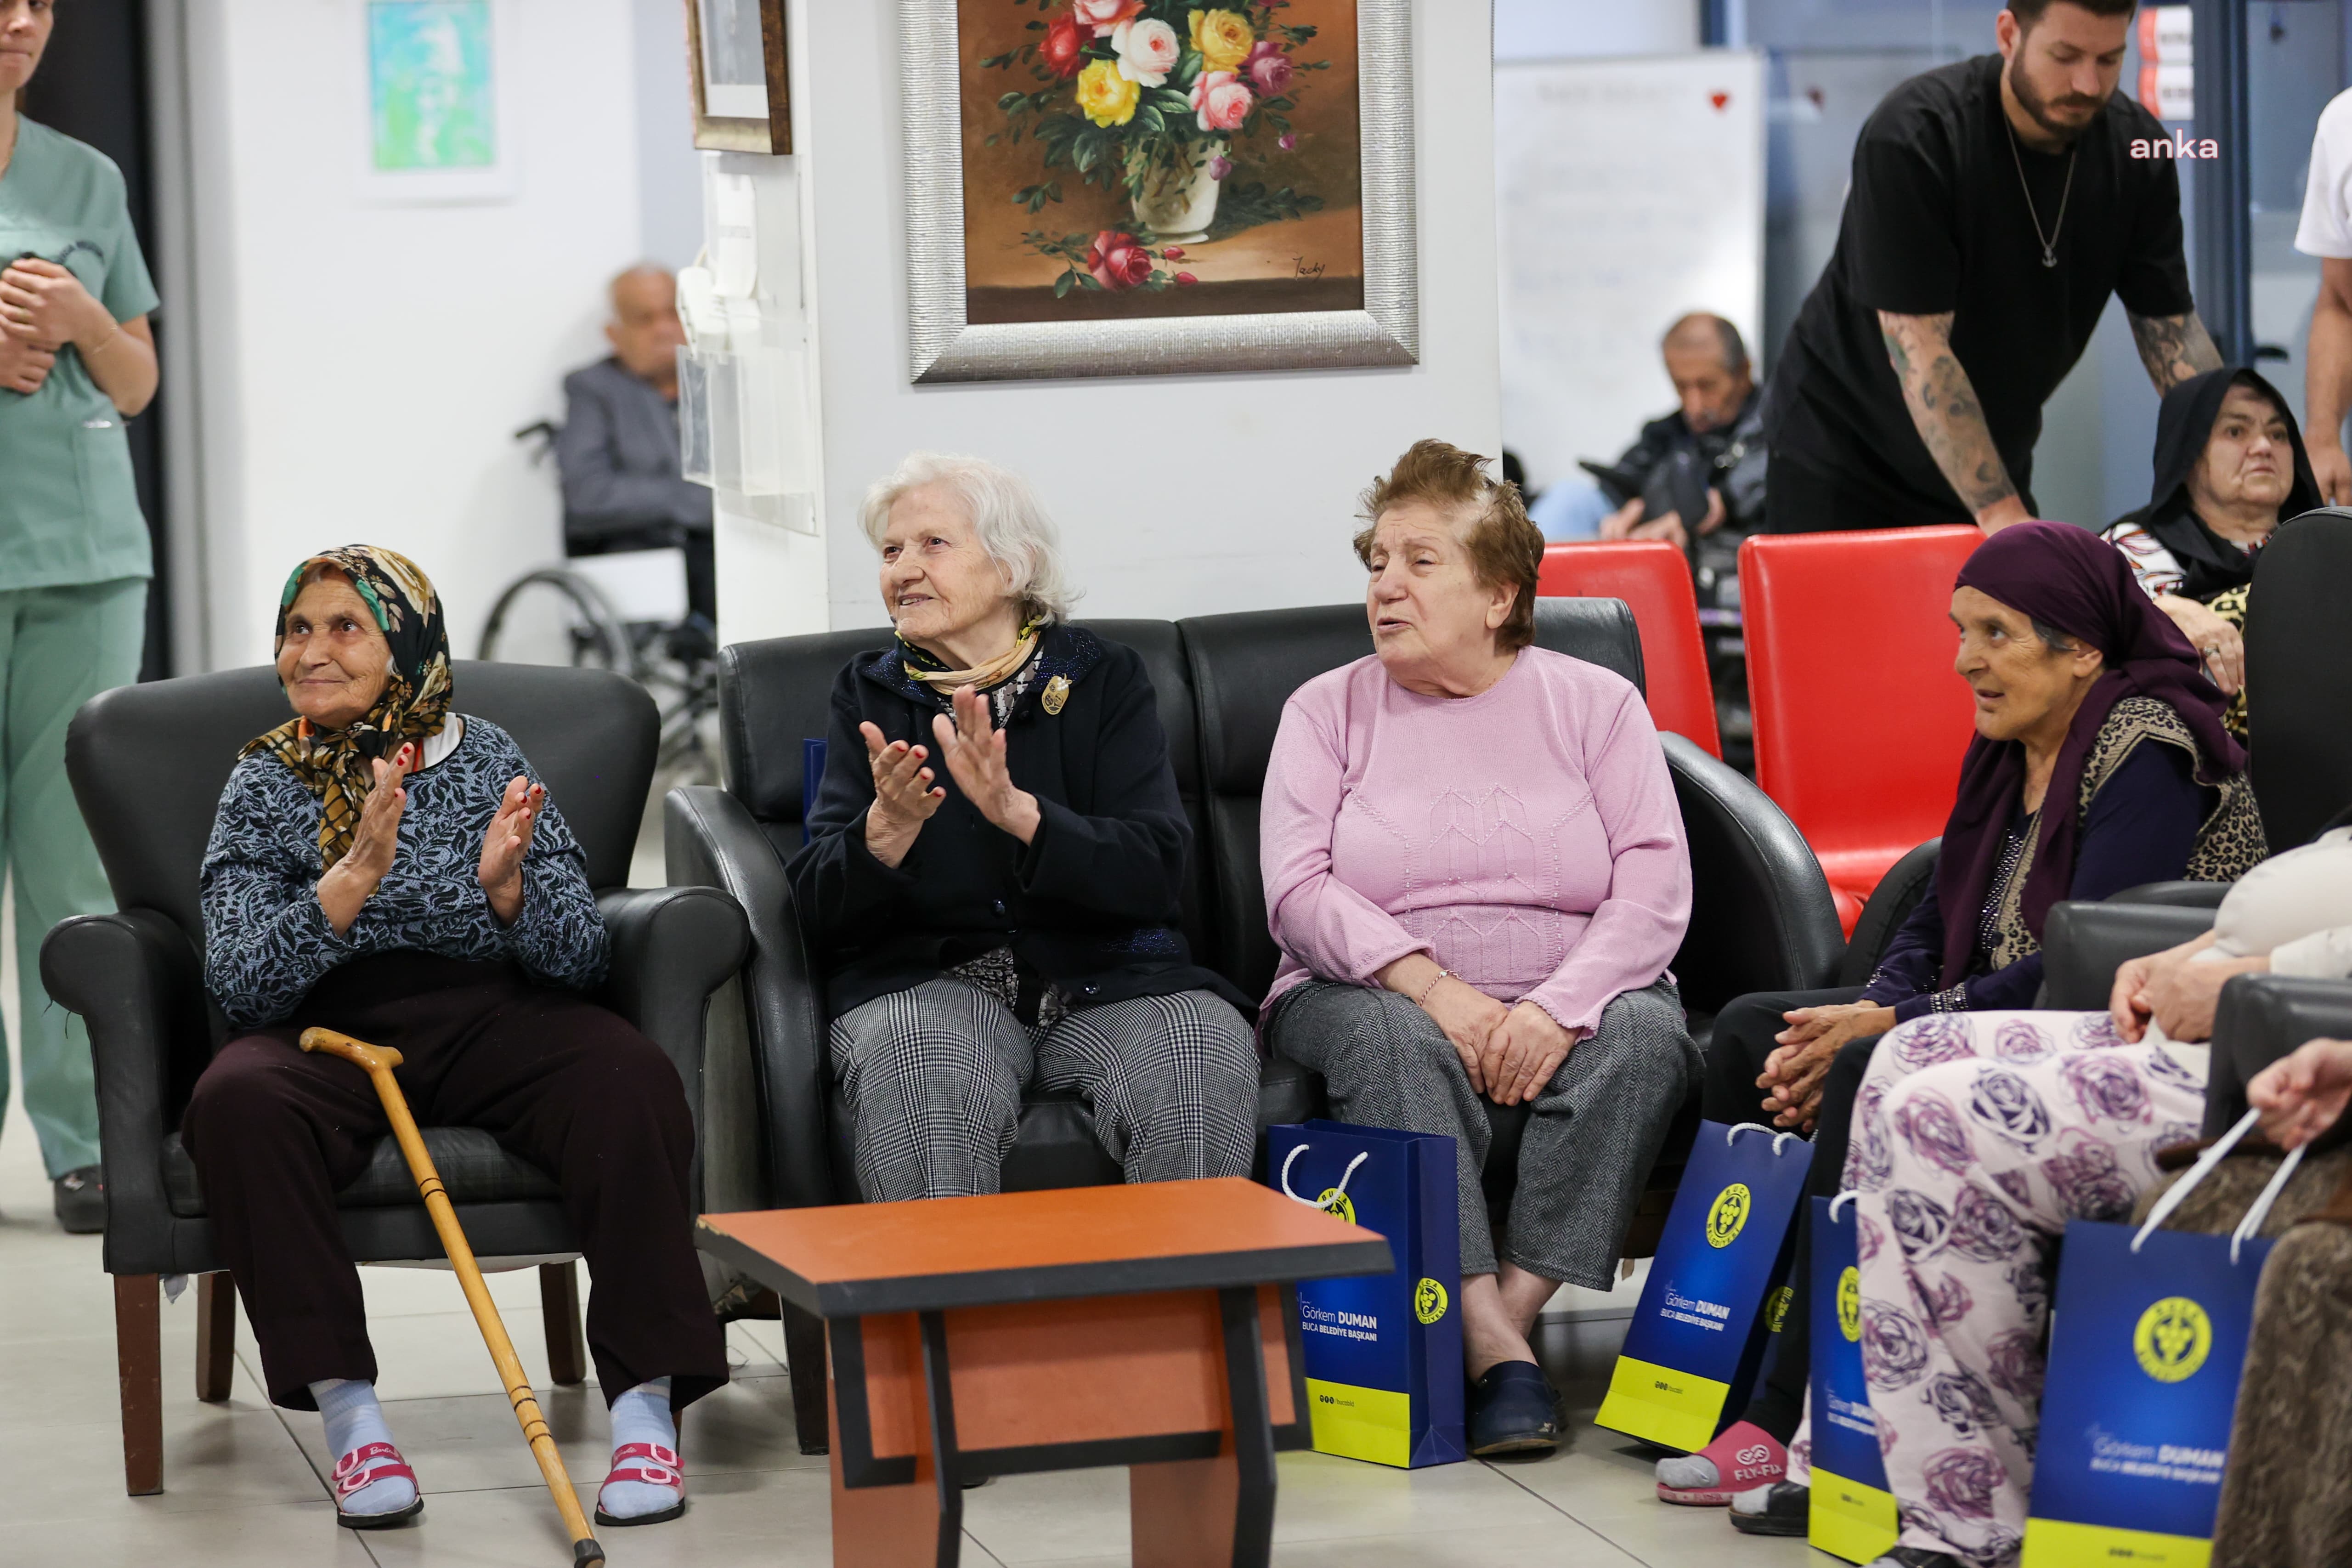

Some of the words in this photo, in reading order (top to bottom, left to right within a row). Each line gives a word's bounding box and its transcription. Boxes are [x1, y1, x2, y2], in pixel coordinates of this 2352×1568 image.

[1322, 1190, 1347, 1205] BUA
[1302, 1305, 1336, 1323] Görkem
[1338, 1311, 1377, 1330] DUMAN
[1695, 1300, 1730, 1319] DUMAN
[1302, 1321, 1318, 1332] BUCA
[1319, 1325, 1347, 1337] BELEDİYE
[1348, 1329, 1377, 1342] BAŞKANI
